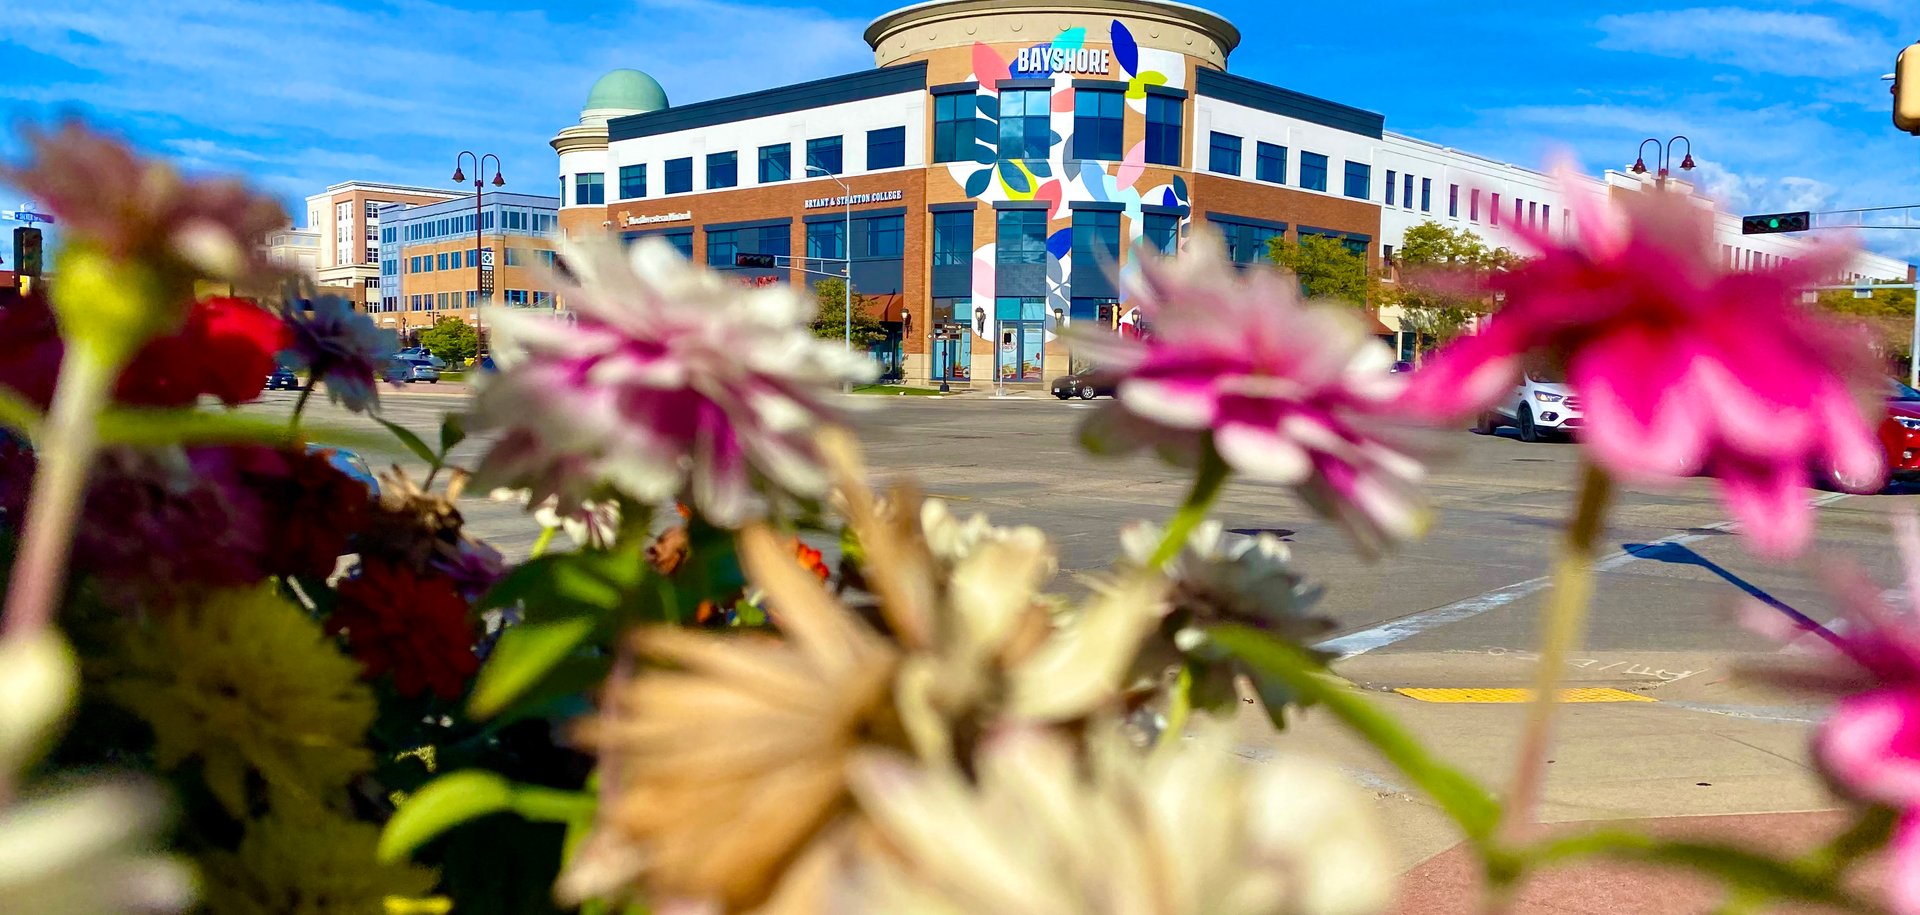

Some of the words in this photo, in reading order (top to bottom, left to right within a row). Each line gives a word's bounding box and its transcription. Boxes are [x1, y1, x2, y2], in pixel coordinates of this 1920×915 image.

[1018, 47, 1109, 75] BAYSHORE
[804, 197, 829, 209] BRYANT
[829, 197, 835, 206] &
[871, 190, 902, 202] COLLEGE
